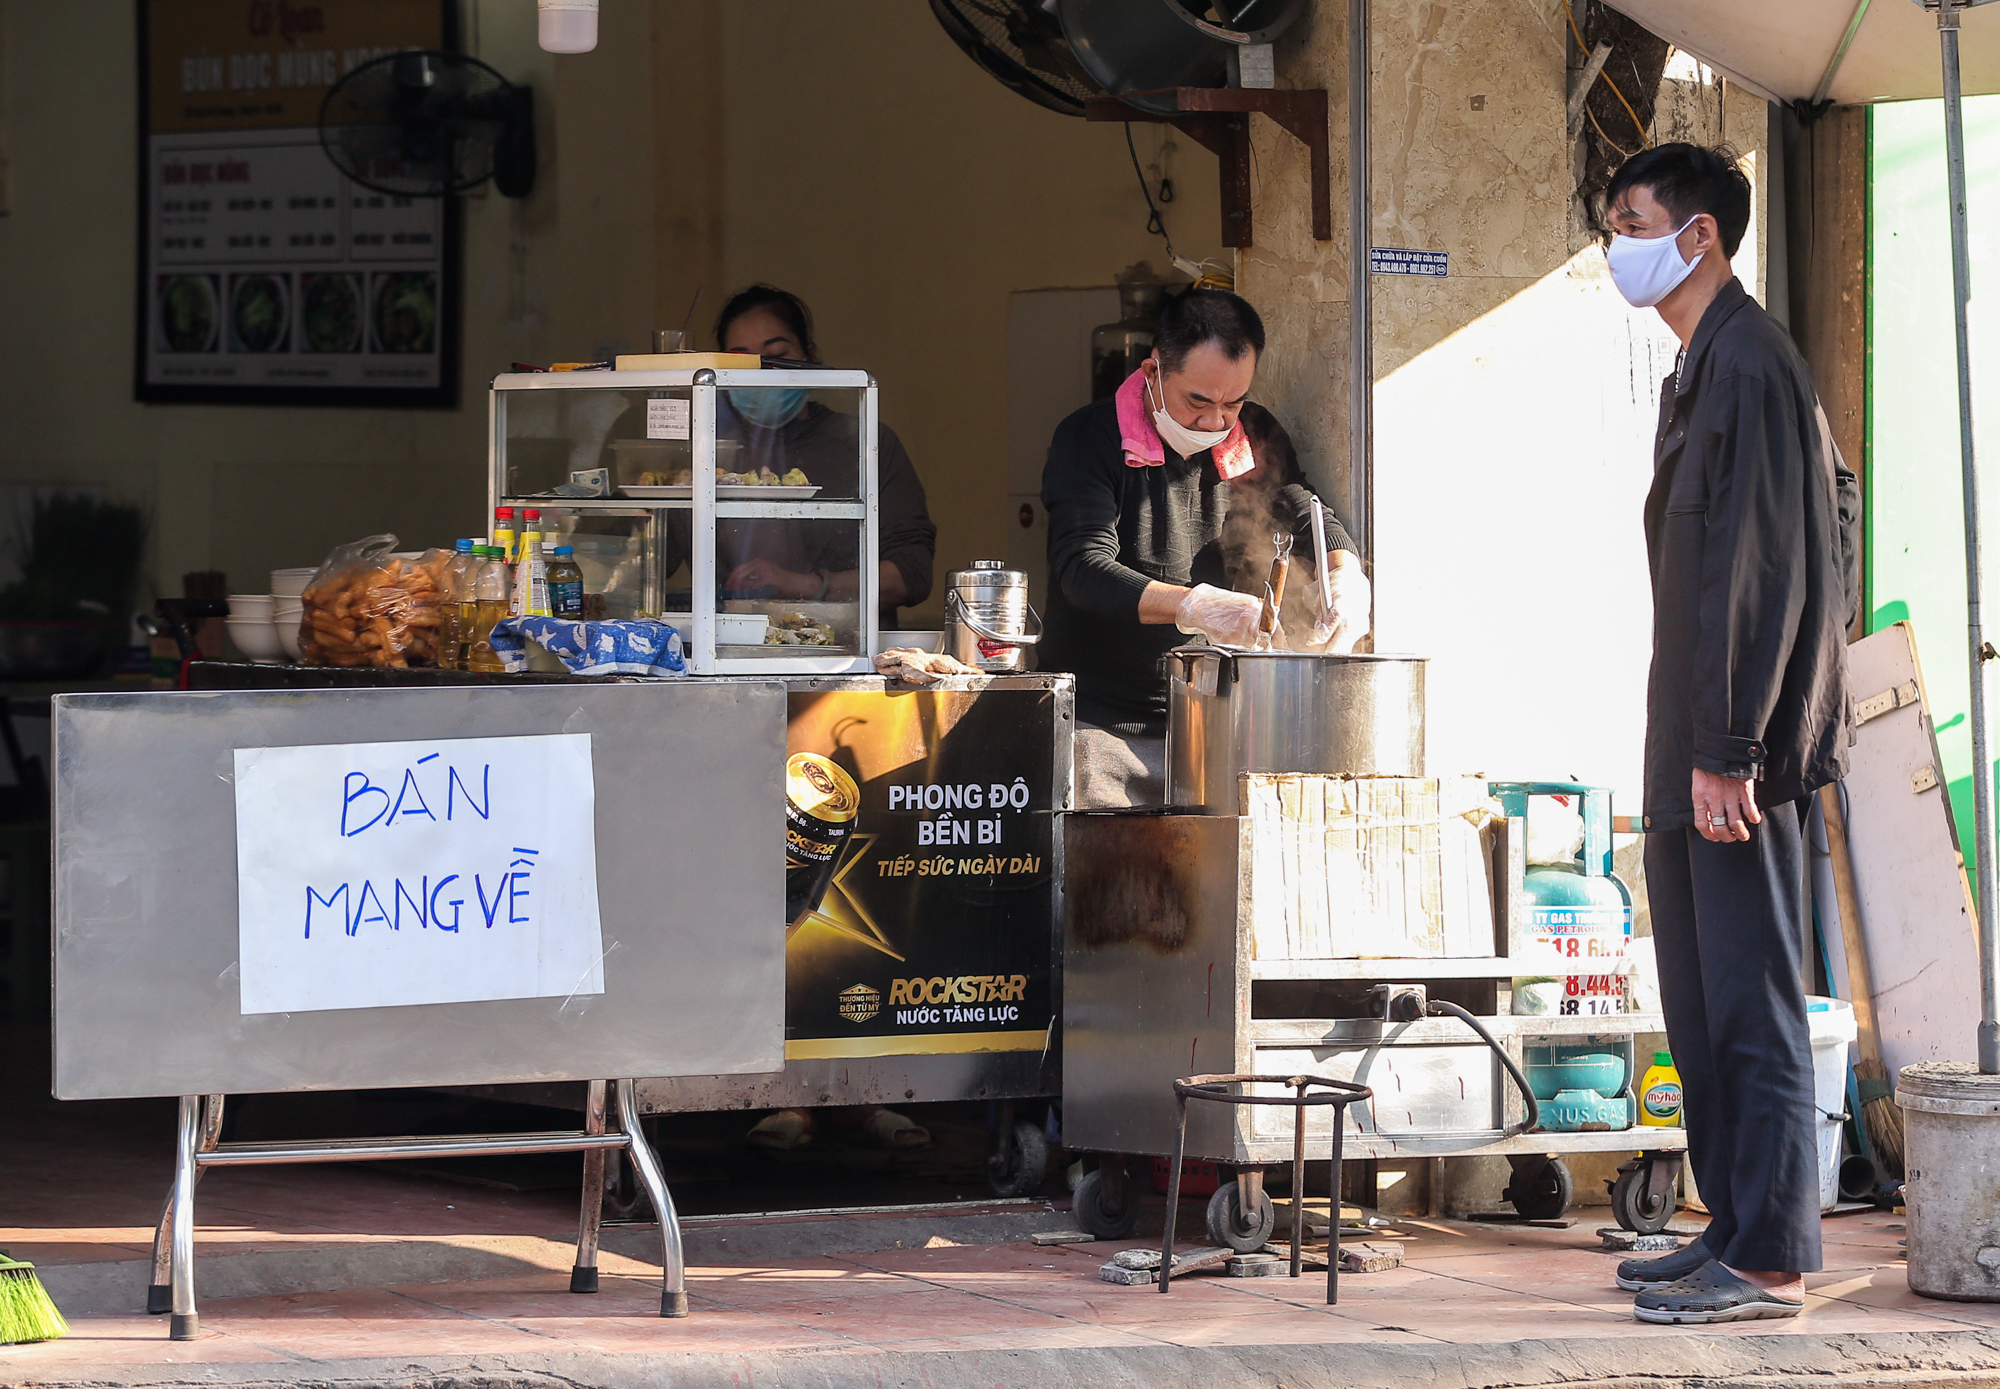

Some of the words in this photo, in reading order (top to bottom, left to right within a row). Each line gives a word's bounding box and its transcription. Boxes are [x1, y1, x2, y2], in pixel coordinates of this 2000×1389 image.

[341, 752, 490, 838] BÁN
[888, 784, 983, 811] PHONG
[988, 776, 1030, 814] ĐỘ
[918, 811, 971, 846] BỀN
[977, 813, 1002, 844] BỈ
[877, 854, 916, 877] TIẾP
[917, 854, 955, 876] SỨC
[957, 853, 1008, 875] NGÀY
[1009, 853, 1041, 874] DÀI
[305, 875, 465, 939] MANG
[475, 847, 540, 929] VỀ
[1531, 925, 1554, 934] GAS
[1535, 912, 1548, 924] TY
[1551, 912, 1572, 924] GAS
[839, 994, 865, 1003] THƯƠNG
[888, 975, 1027, 1005] ROCKSTAR
[839, 1002, 856, 1012] ĐẾN
[856, 1002, 867, 1012] TỪ
[896, 1006, 940, 1025] NƯỚC
[943, 1005, 985, 1023] TĂNG
[988, 1005, 1019, 1025] LỰC
